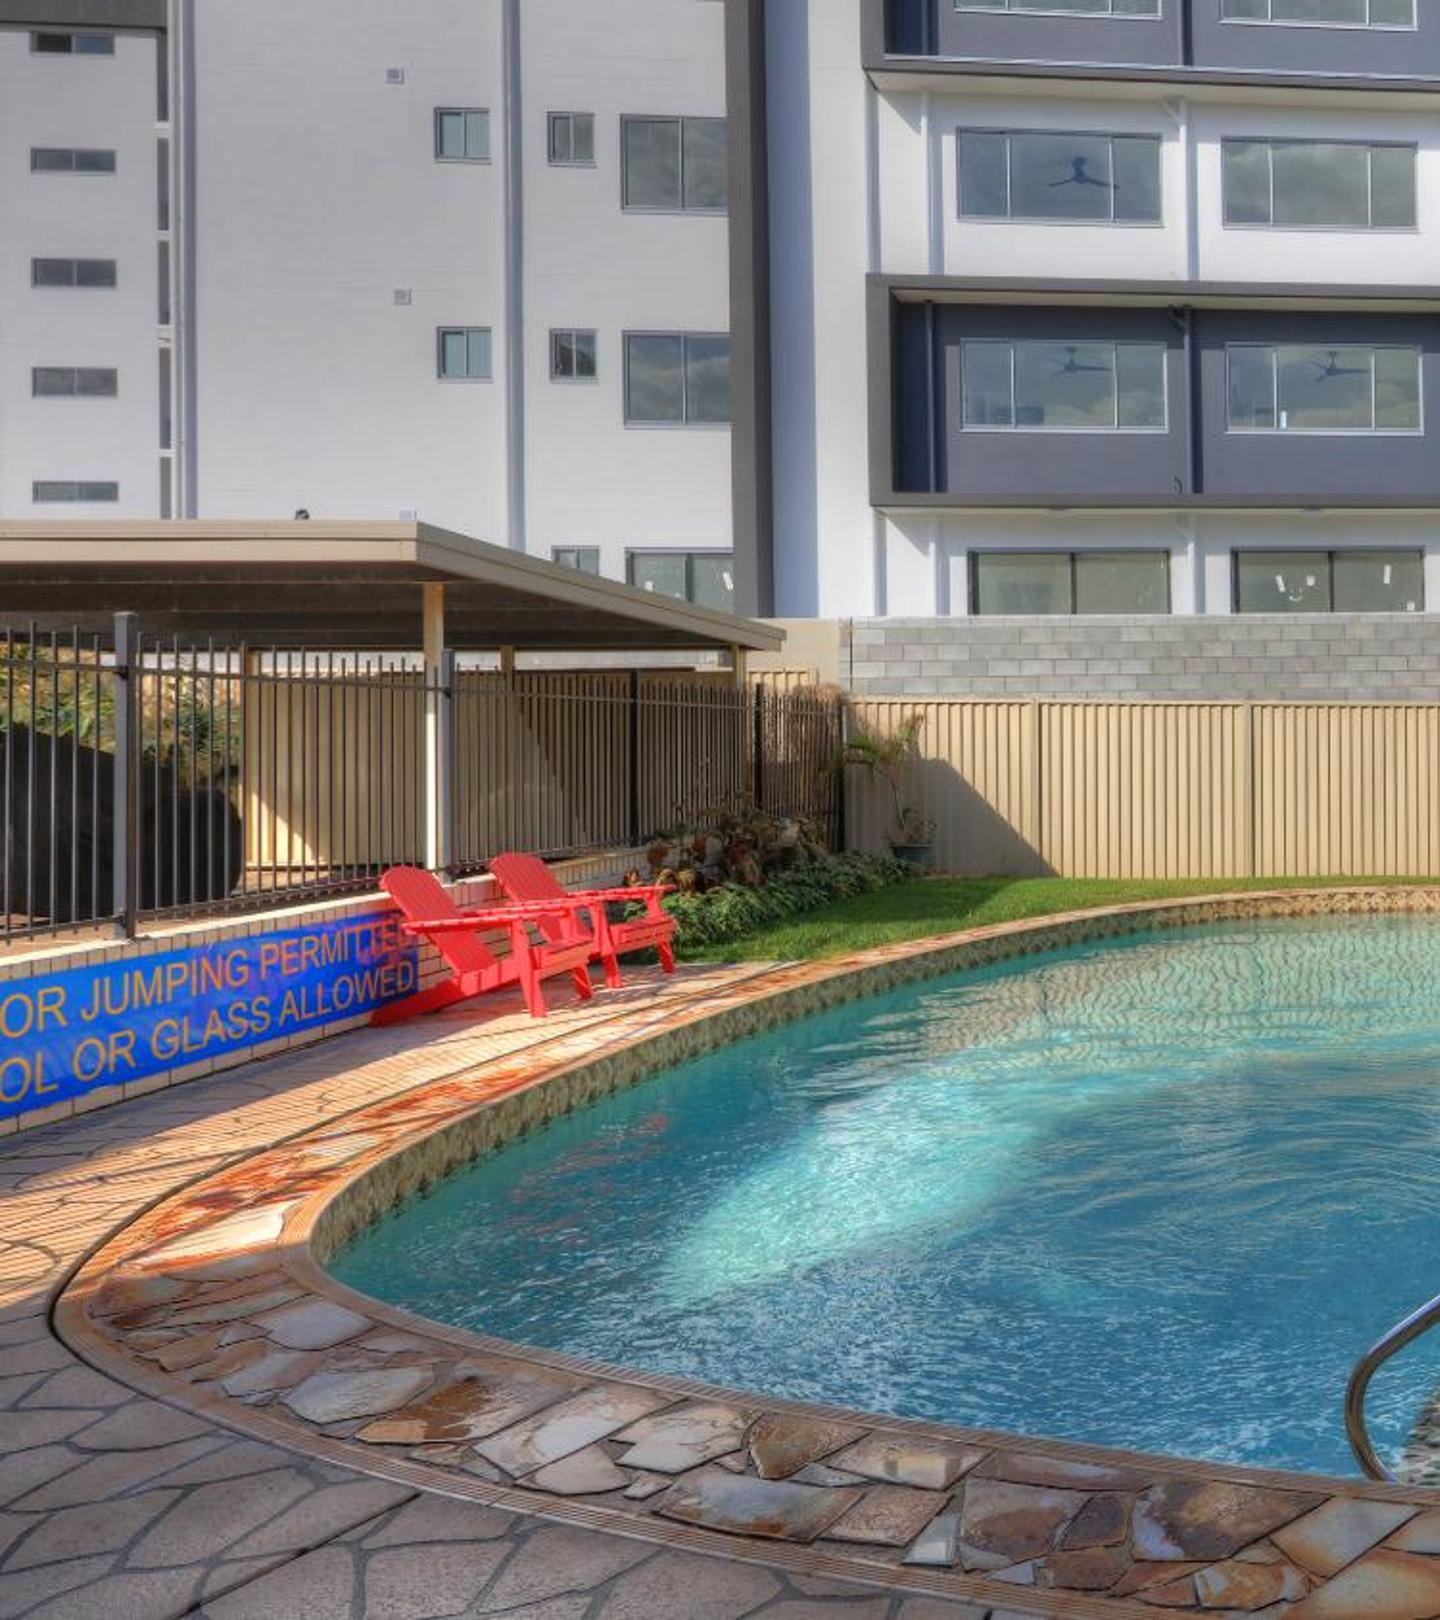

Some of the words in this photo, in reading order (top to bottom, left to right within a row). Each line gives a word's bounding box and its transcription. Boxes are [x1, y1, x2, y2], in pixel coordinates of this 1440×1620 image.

[0, 986, 68, 1038] OR
[81, 949, 249, 1021] JUMPING
[72, 1030, 137, 1081] OR
[151, 996, 271, 1060] GLASS
[278, 960, 414, 1027] ALLOWED
